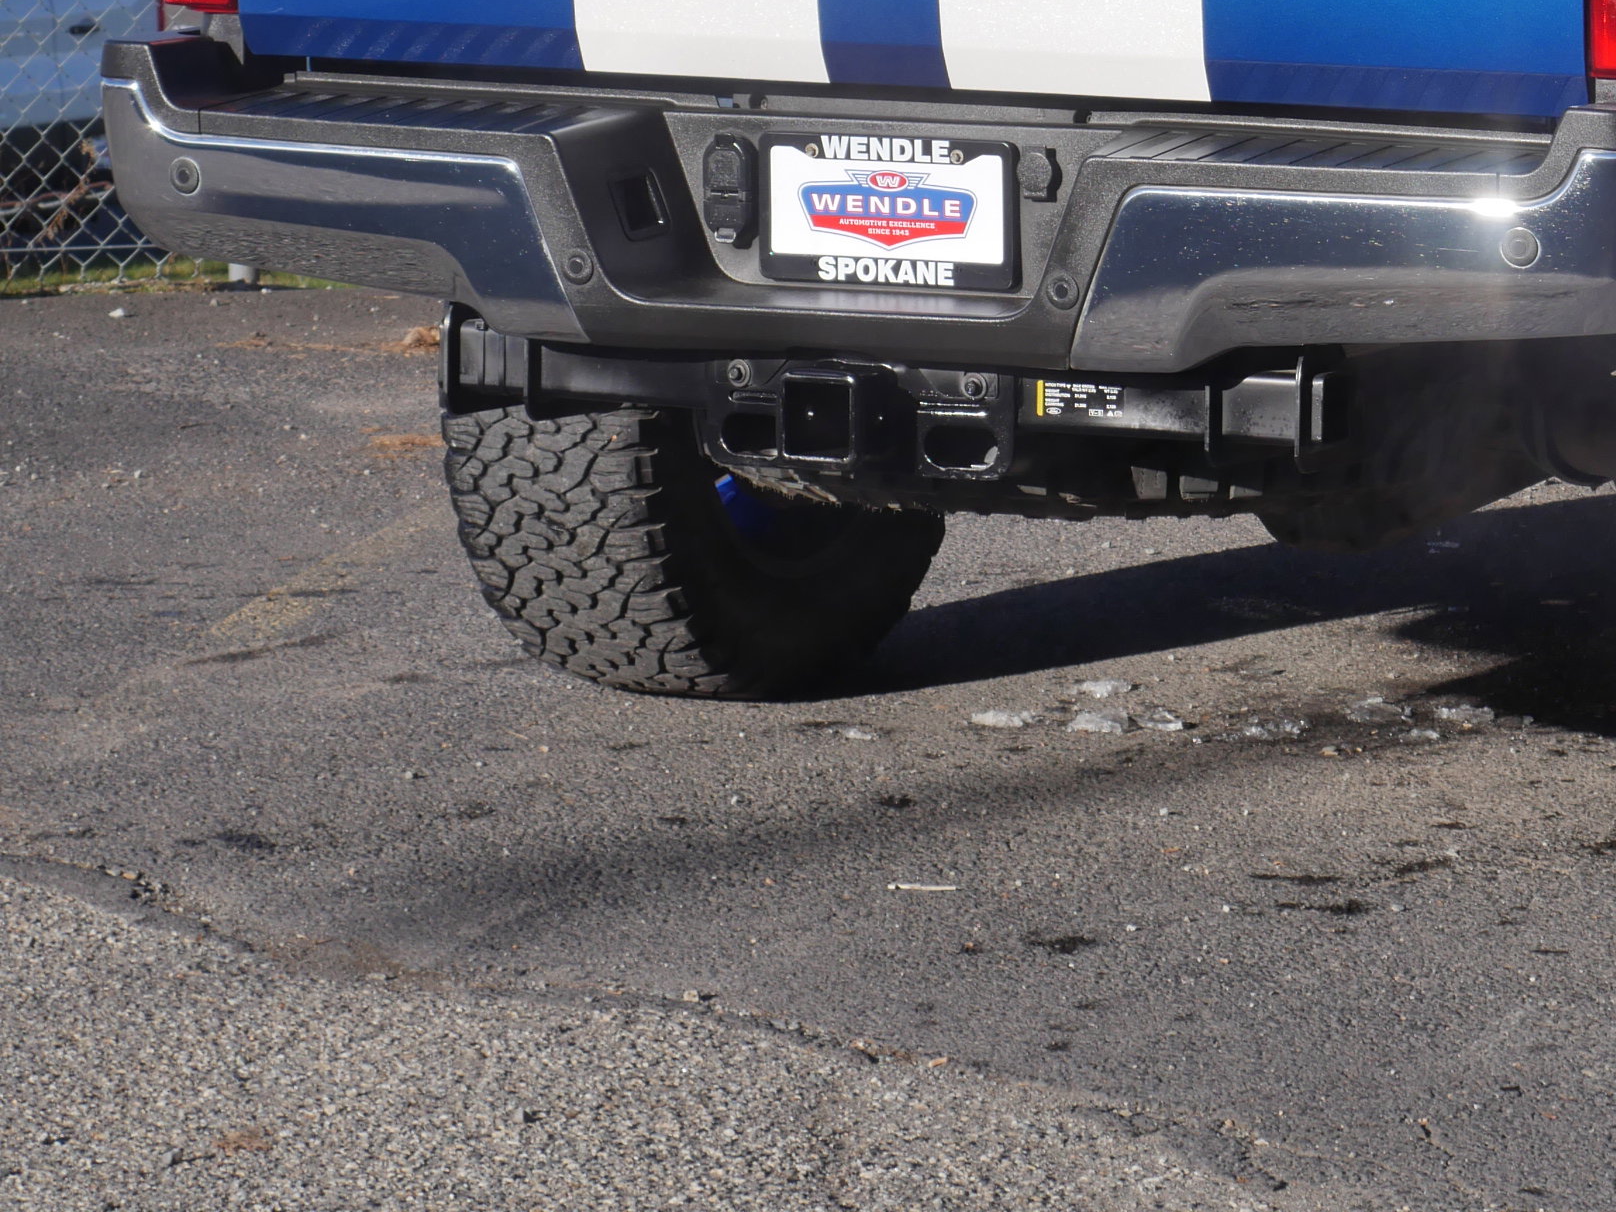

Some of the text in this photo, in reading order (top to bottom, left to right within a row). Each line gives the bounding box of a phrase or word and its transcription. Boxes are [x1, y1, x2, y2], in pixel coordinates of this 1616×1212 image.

[821, 135, 950, 163] WENDLE
[811, 193, 961, 218] WENDLE
[839, 218, 935, 229] AUTOMOTIVE EXCELLENCE
[818, 256, 954, 286] SPOKANE
